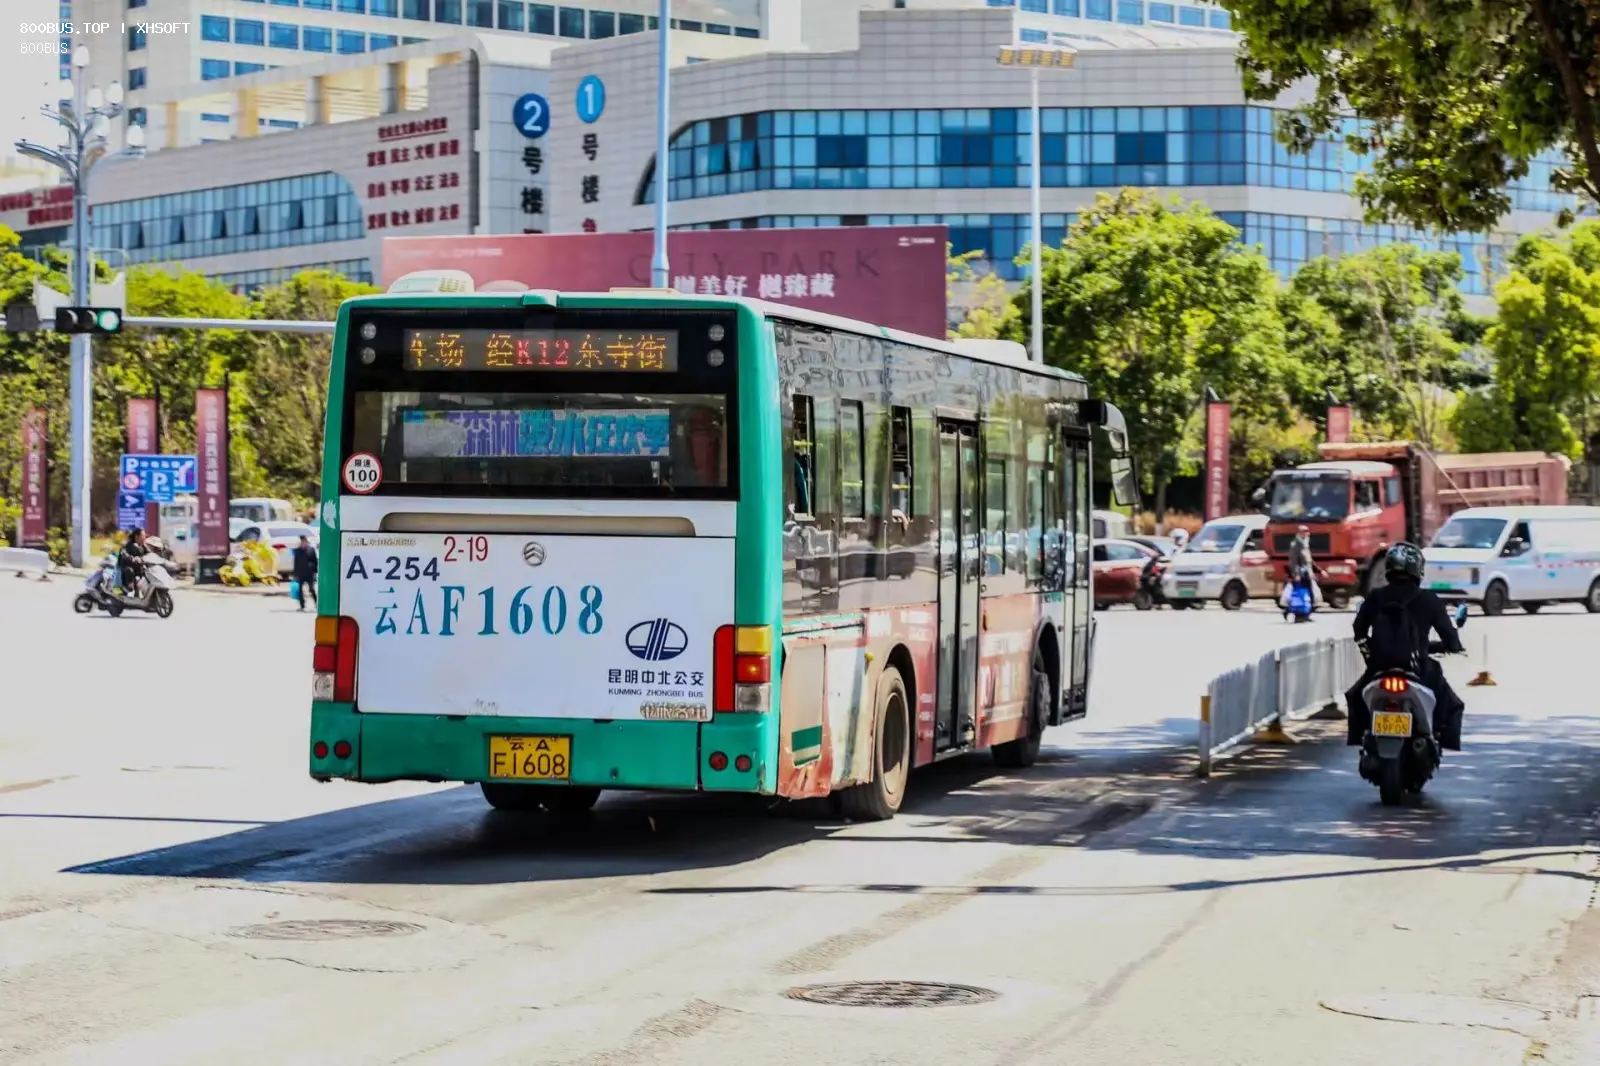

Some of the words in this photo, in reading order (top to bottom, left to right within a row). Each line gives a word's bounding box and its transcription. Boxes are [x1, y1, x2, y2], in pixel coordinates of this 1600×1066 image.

[355, 459, 371, 467] 限速
[349, 469, 377, 482] 100
[443, 536, 489, 562] 2-19
[346, 555, 440, 582] A-254
[374, 585, 603, 636] 云AF1608
[608, 668, 704, 686] 昆明中北公交
[608, 687, 642, 696] KUNMING
[646, 689, 685, 697] ZHONGBEI
[493, 752, 566, 776] F1608
